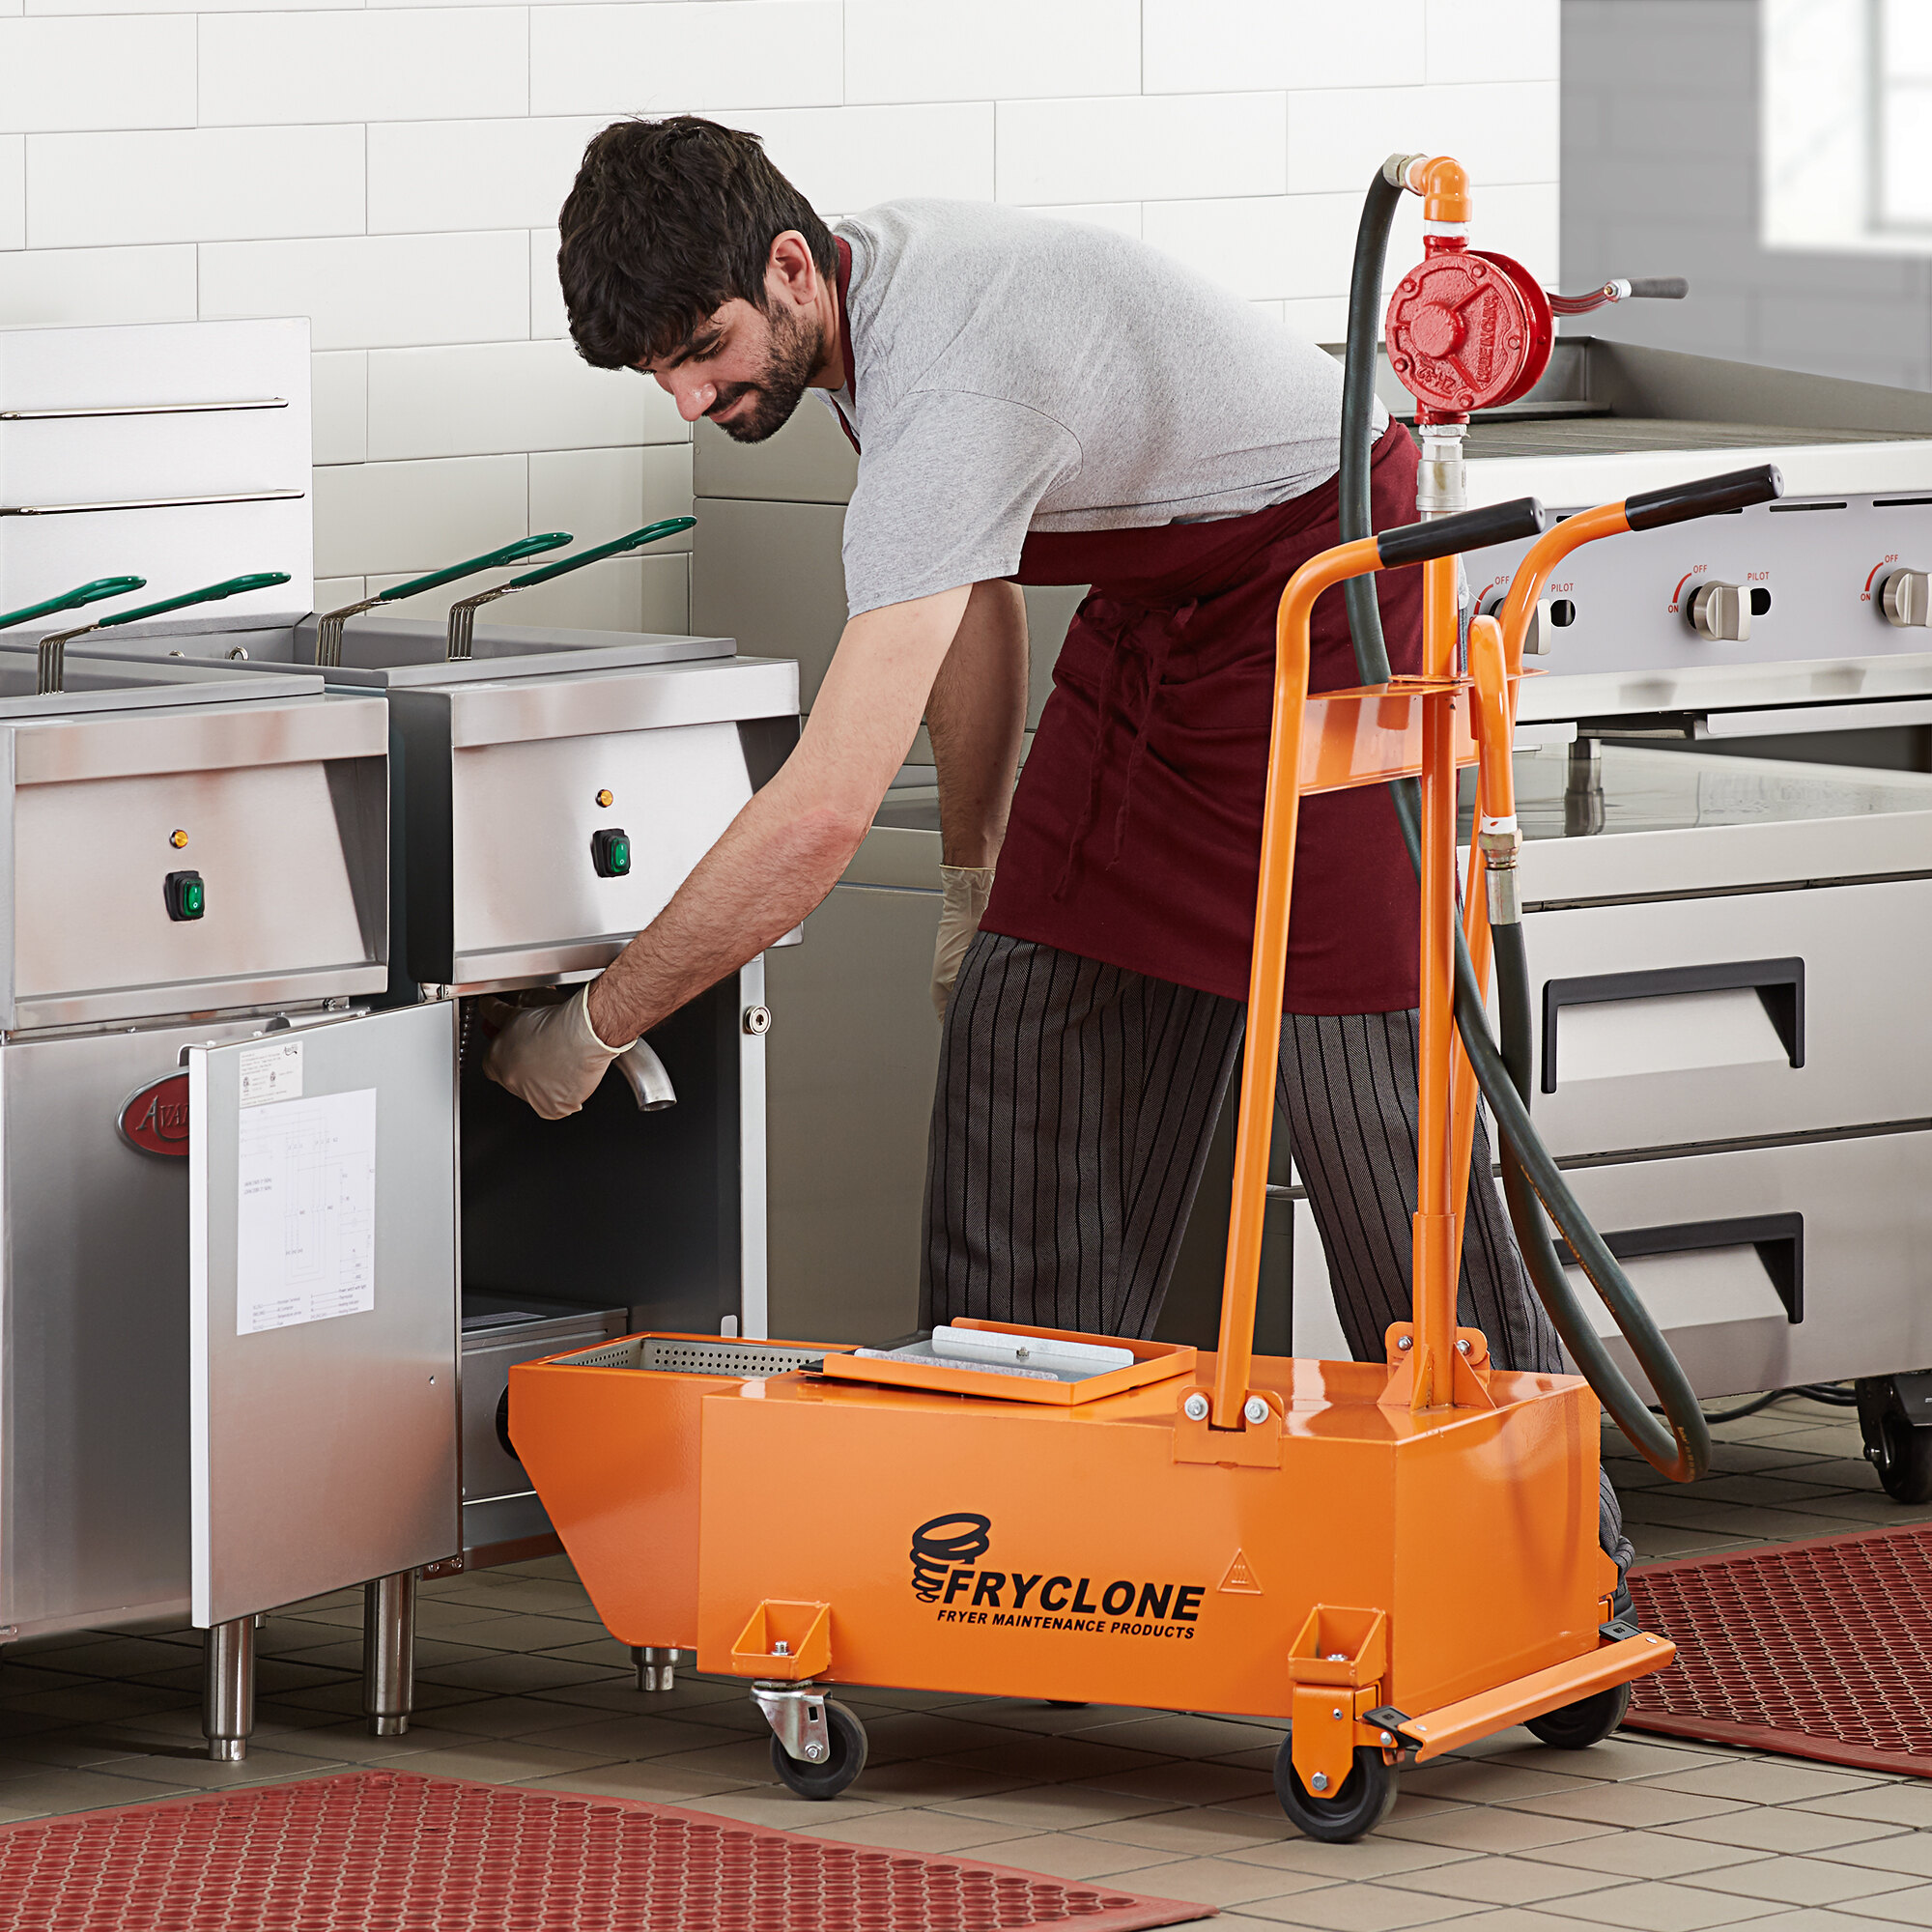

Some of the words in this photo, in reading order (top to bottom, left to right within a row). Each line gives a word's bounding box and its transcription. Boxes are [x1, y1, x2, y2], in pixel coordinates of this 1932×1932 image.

[1480, 296, 1498, 333] CHINA
[1479, 333, 1495, 347] IN
[1885, 554, 1898, 563] OFF
[1692, 564, 1708, 574] OFF
[1494, 576, 1510, 585] OFF
[1747, 571, 1770, 581] PILOT
[1550, 582, 1575, 592] PILOT
[1861, 593, 1871, 602] ON
[1667, 605, 1679, 613] ON
[943, 1569, 1207, 1622] FRYCLONE
[937, 1609, 988, 1625] FRYER
[992, 1613, 1107, 1633] MAINTENANCE
[1110, 1622, 1196, 1640] PRODUCTS
